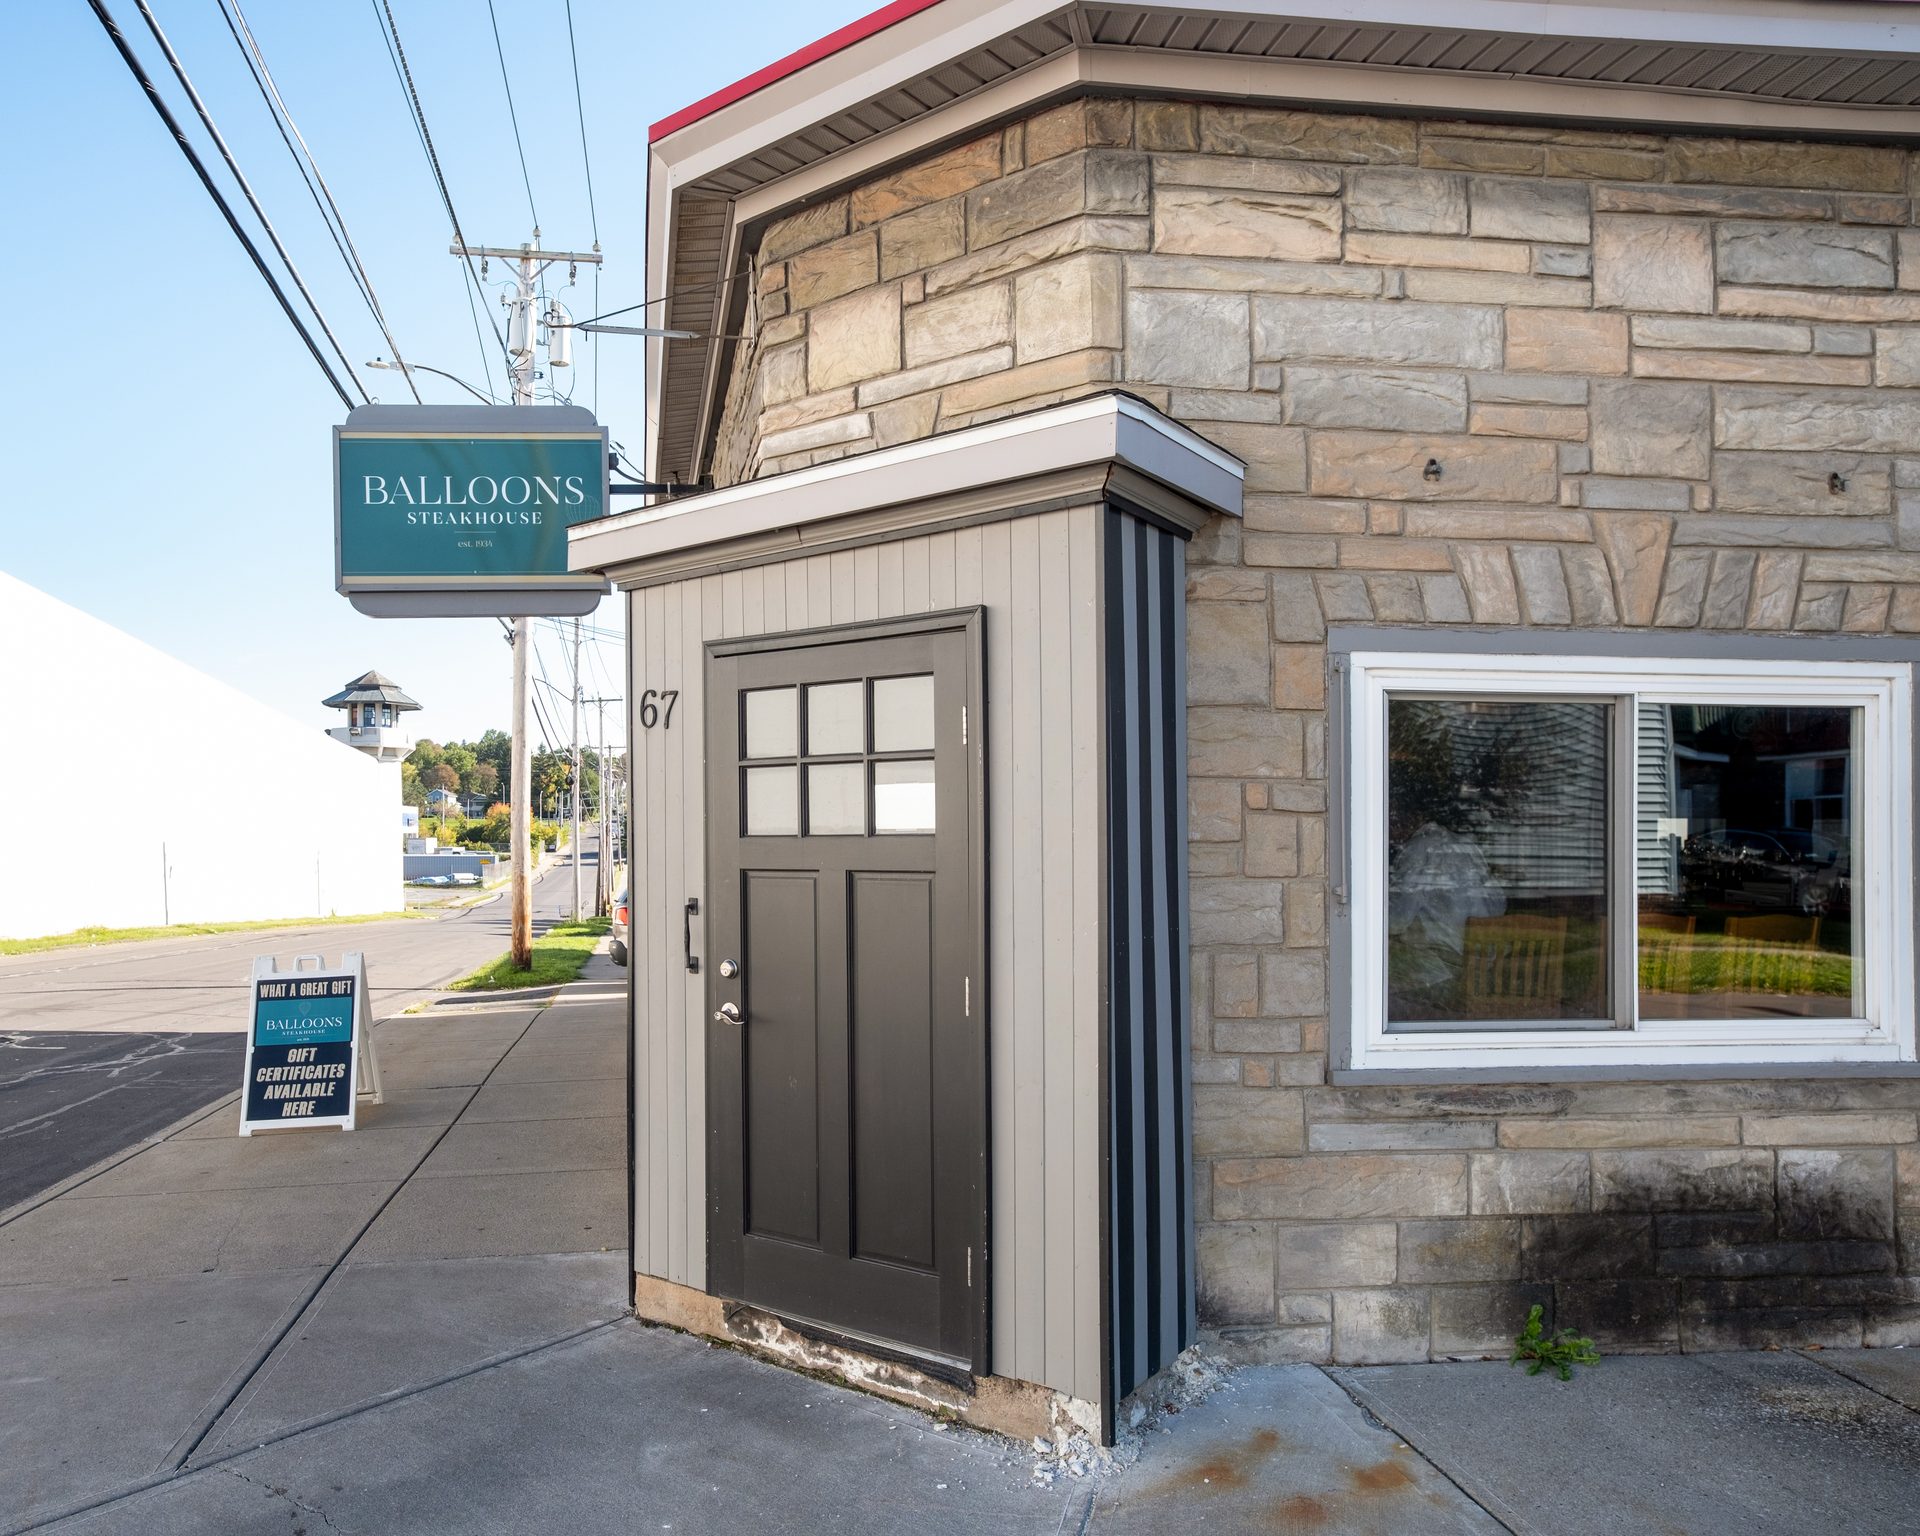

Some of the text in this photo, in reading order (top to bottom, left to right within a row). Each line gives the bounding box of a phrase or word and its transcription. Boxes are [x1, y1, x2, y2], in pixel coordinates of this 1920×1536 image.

[363, 475, 584, 505] BALLOONS
[407, 511, 542, 525] STEAKHOUSE
[457, 540, 473, 548] est.
[640, 689, 679, 729] 67
[260, 980, 352, 998] WHAT A GREAT GIFT
[266, 1016, 343, 1031] BALLOONS
[287, 1047, 318, 1063] GIFT
[256, 1063, 346, 1082] CERTIFICATES
[263, 1081, 336, 1099] AVAILABLE
[281, 1100, 316, 1117] HERE
